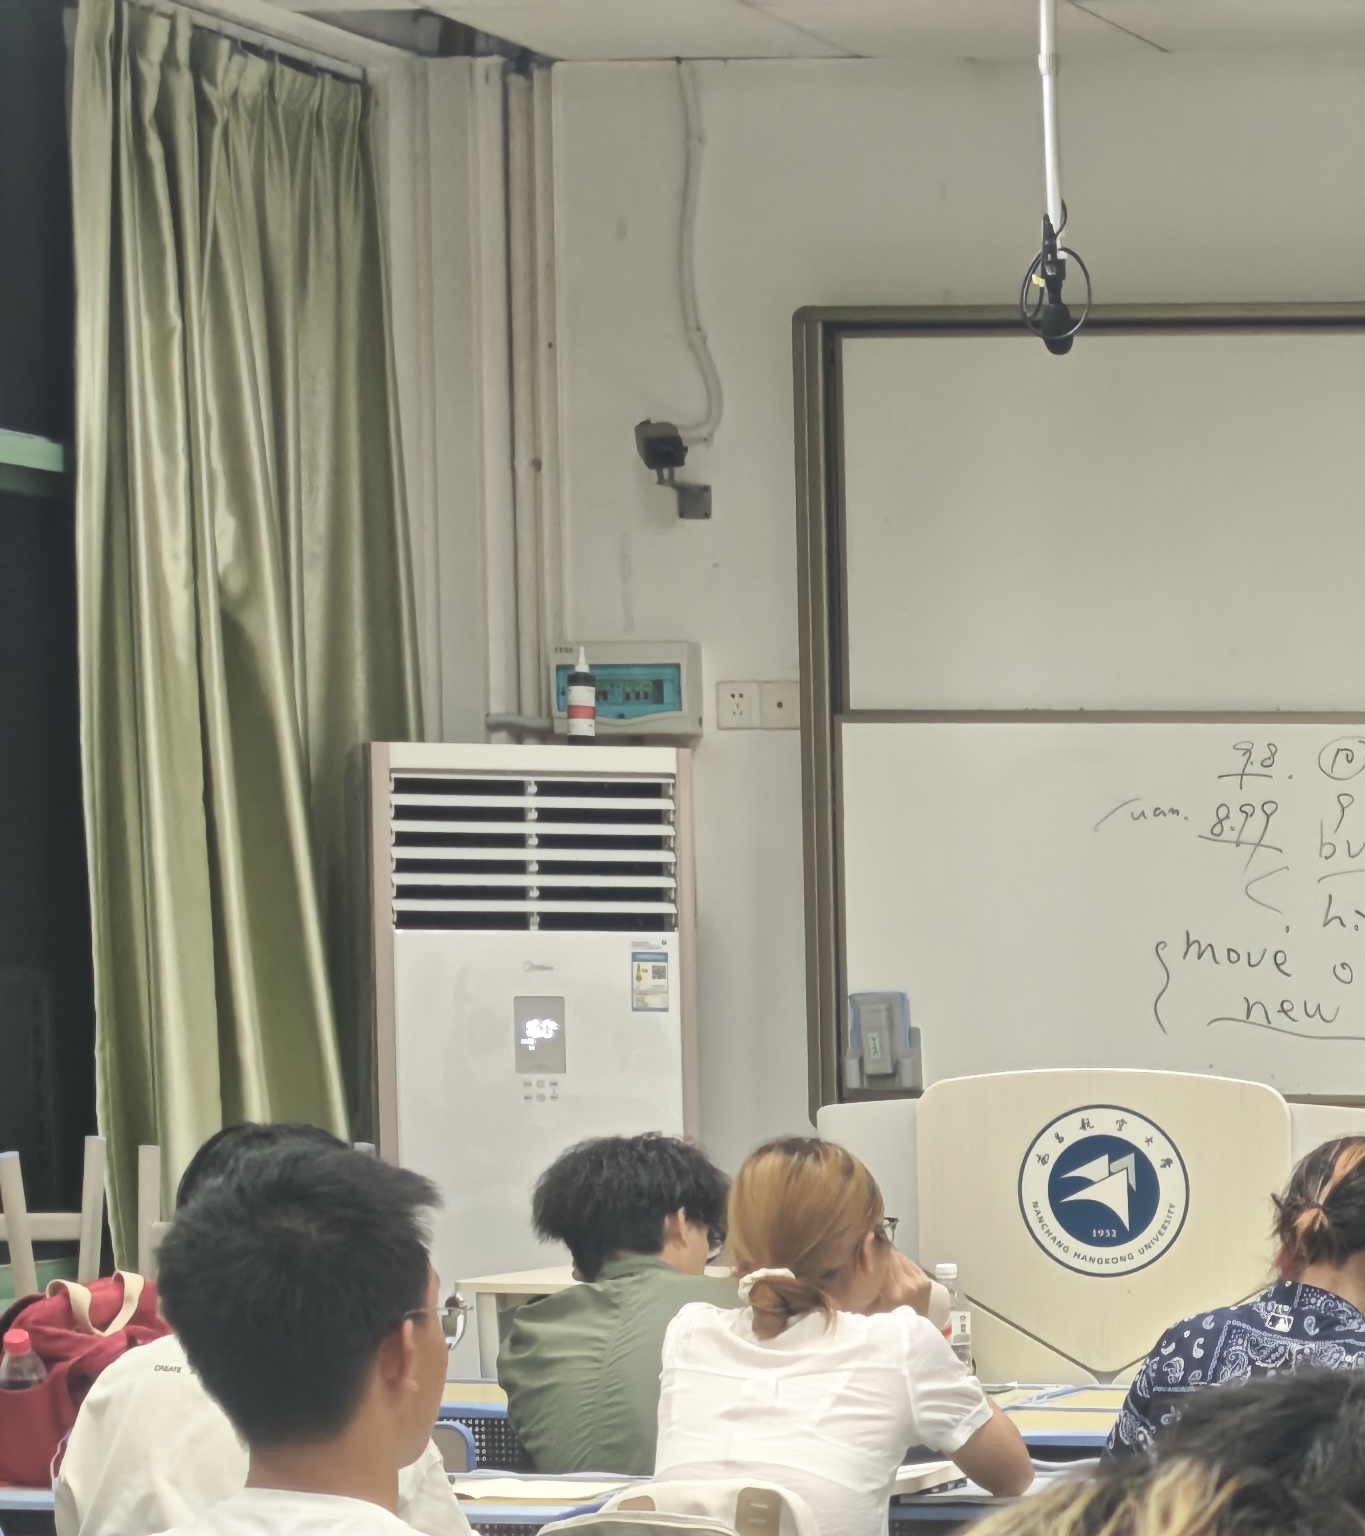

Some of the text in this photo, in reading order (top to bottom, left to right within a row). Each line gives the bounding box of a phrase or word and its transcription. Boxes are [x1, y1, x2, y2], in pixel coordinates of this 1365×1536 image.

[1183, 930, 1291, 977] move
[1244, 997, 1340, 1024] new
[1032, 1201, 1176, 1265] NANCHANG HANGKONG UNIVERSITY
[1092, 1229, 1117, 1238] 1952
